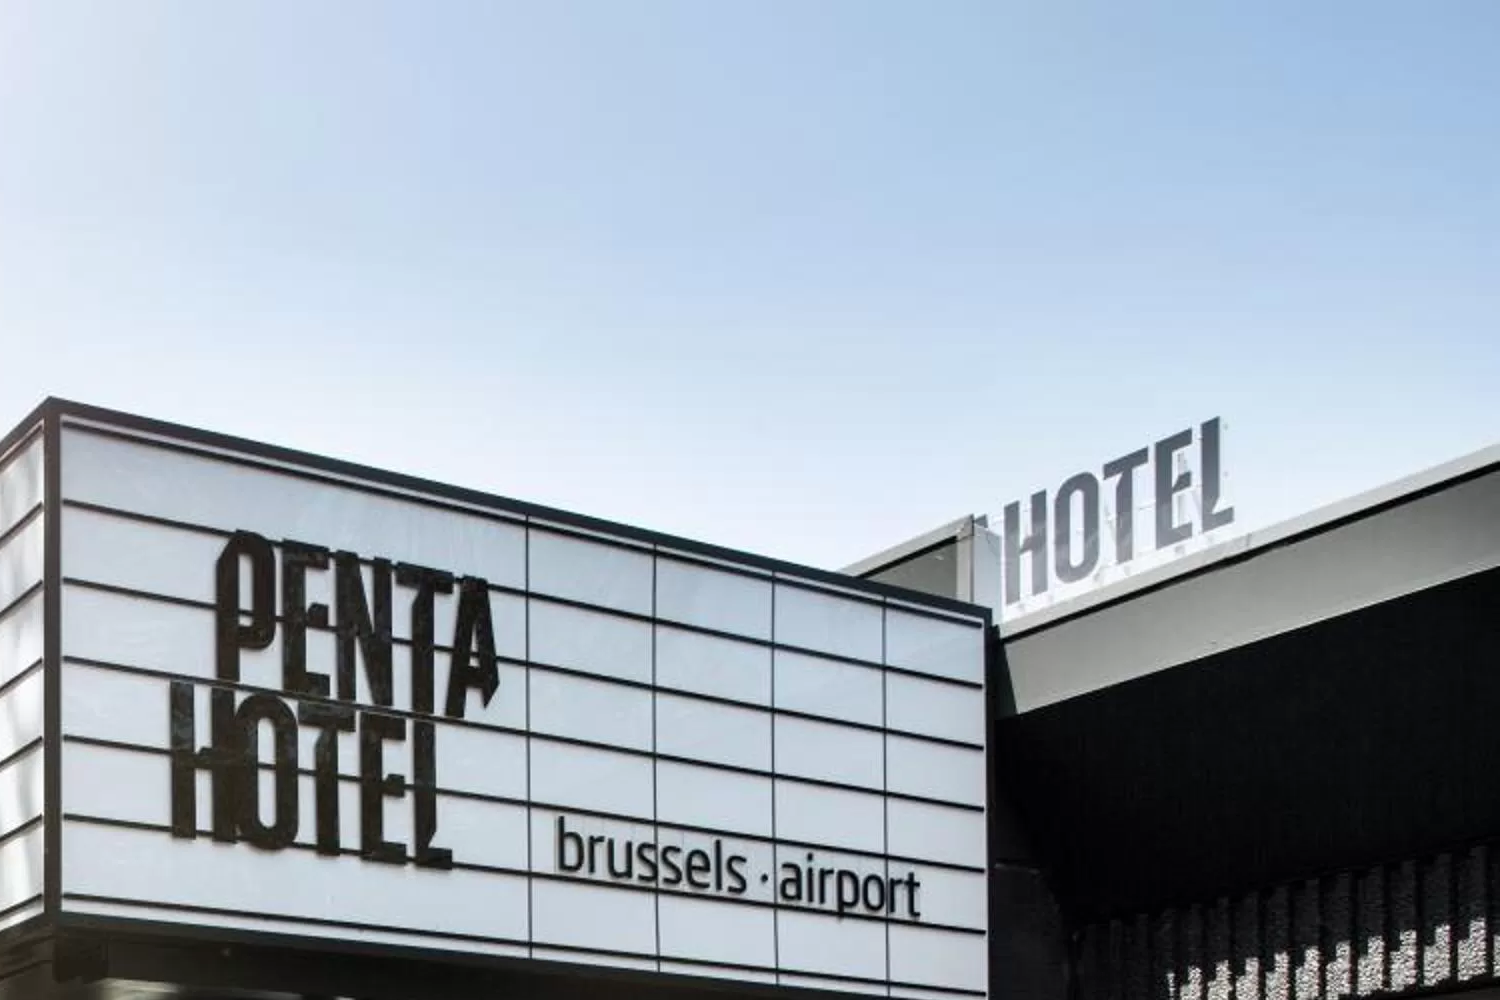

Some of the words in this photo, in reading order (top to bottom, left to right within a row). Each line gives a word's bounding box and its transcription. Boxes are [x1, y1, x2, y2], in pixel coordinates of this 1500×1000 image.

[1003, 416, 1235, 606] HOTEL
[215, 529, 500, 719] PENTA
[169, 680, 453, 870] HOTEL
[556, 815, 748, 896] brussels
[779, 852, 921, 922] airport
